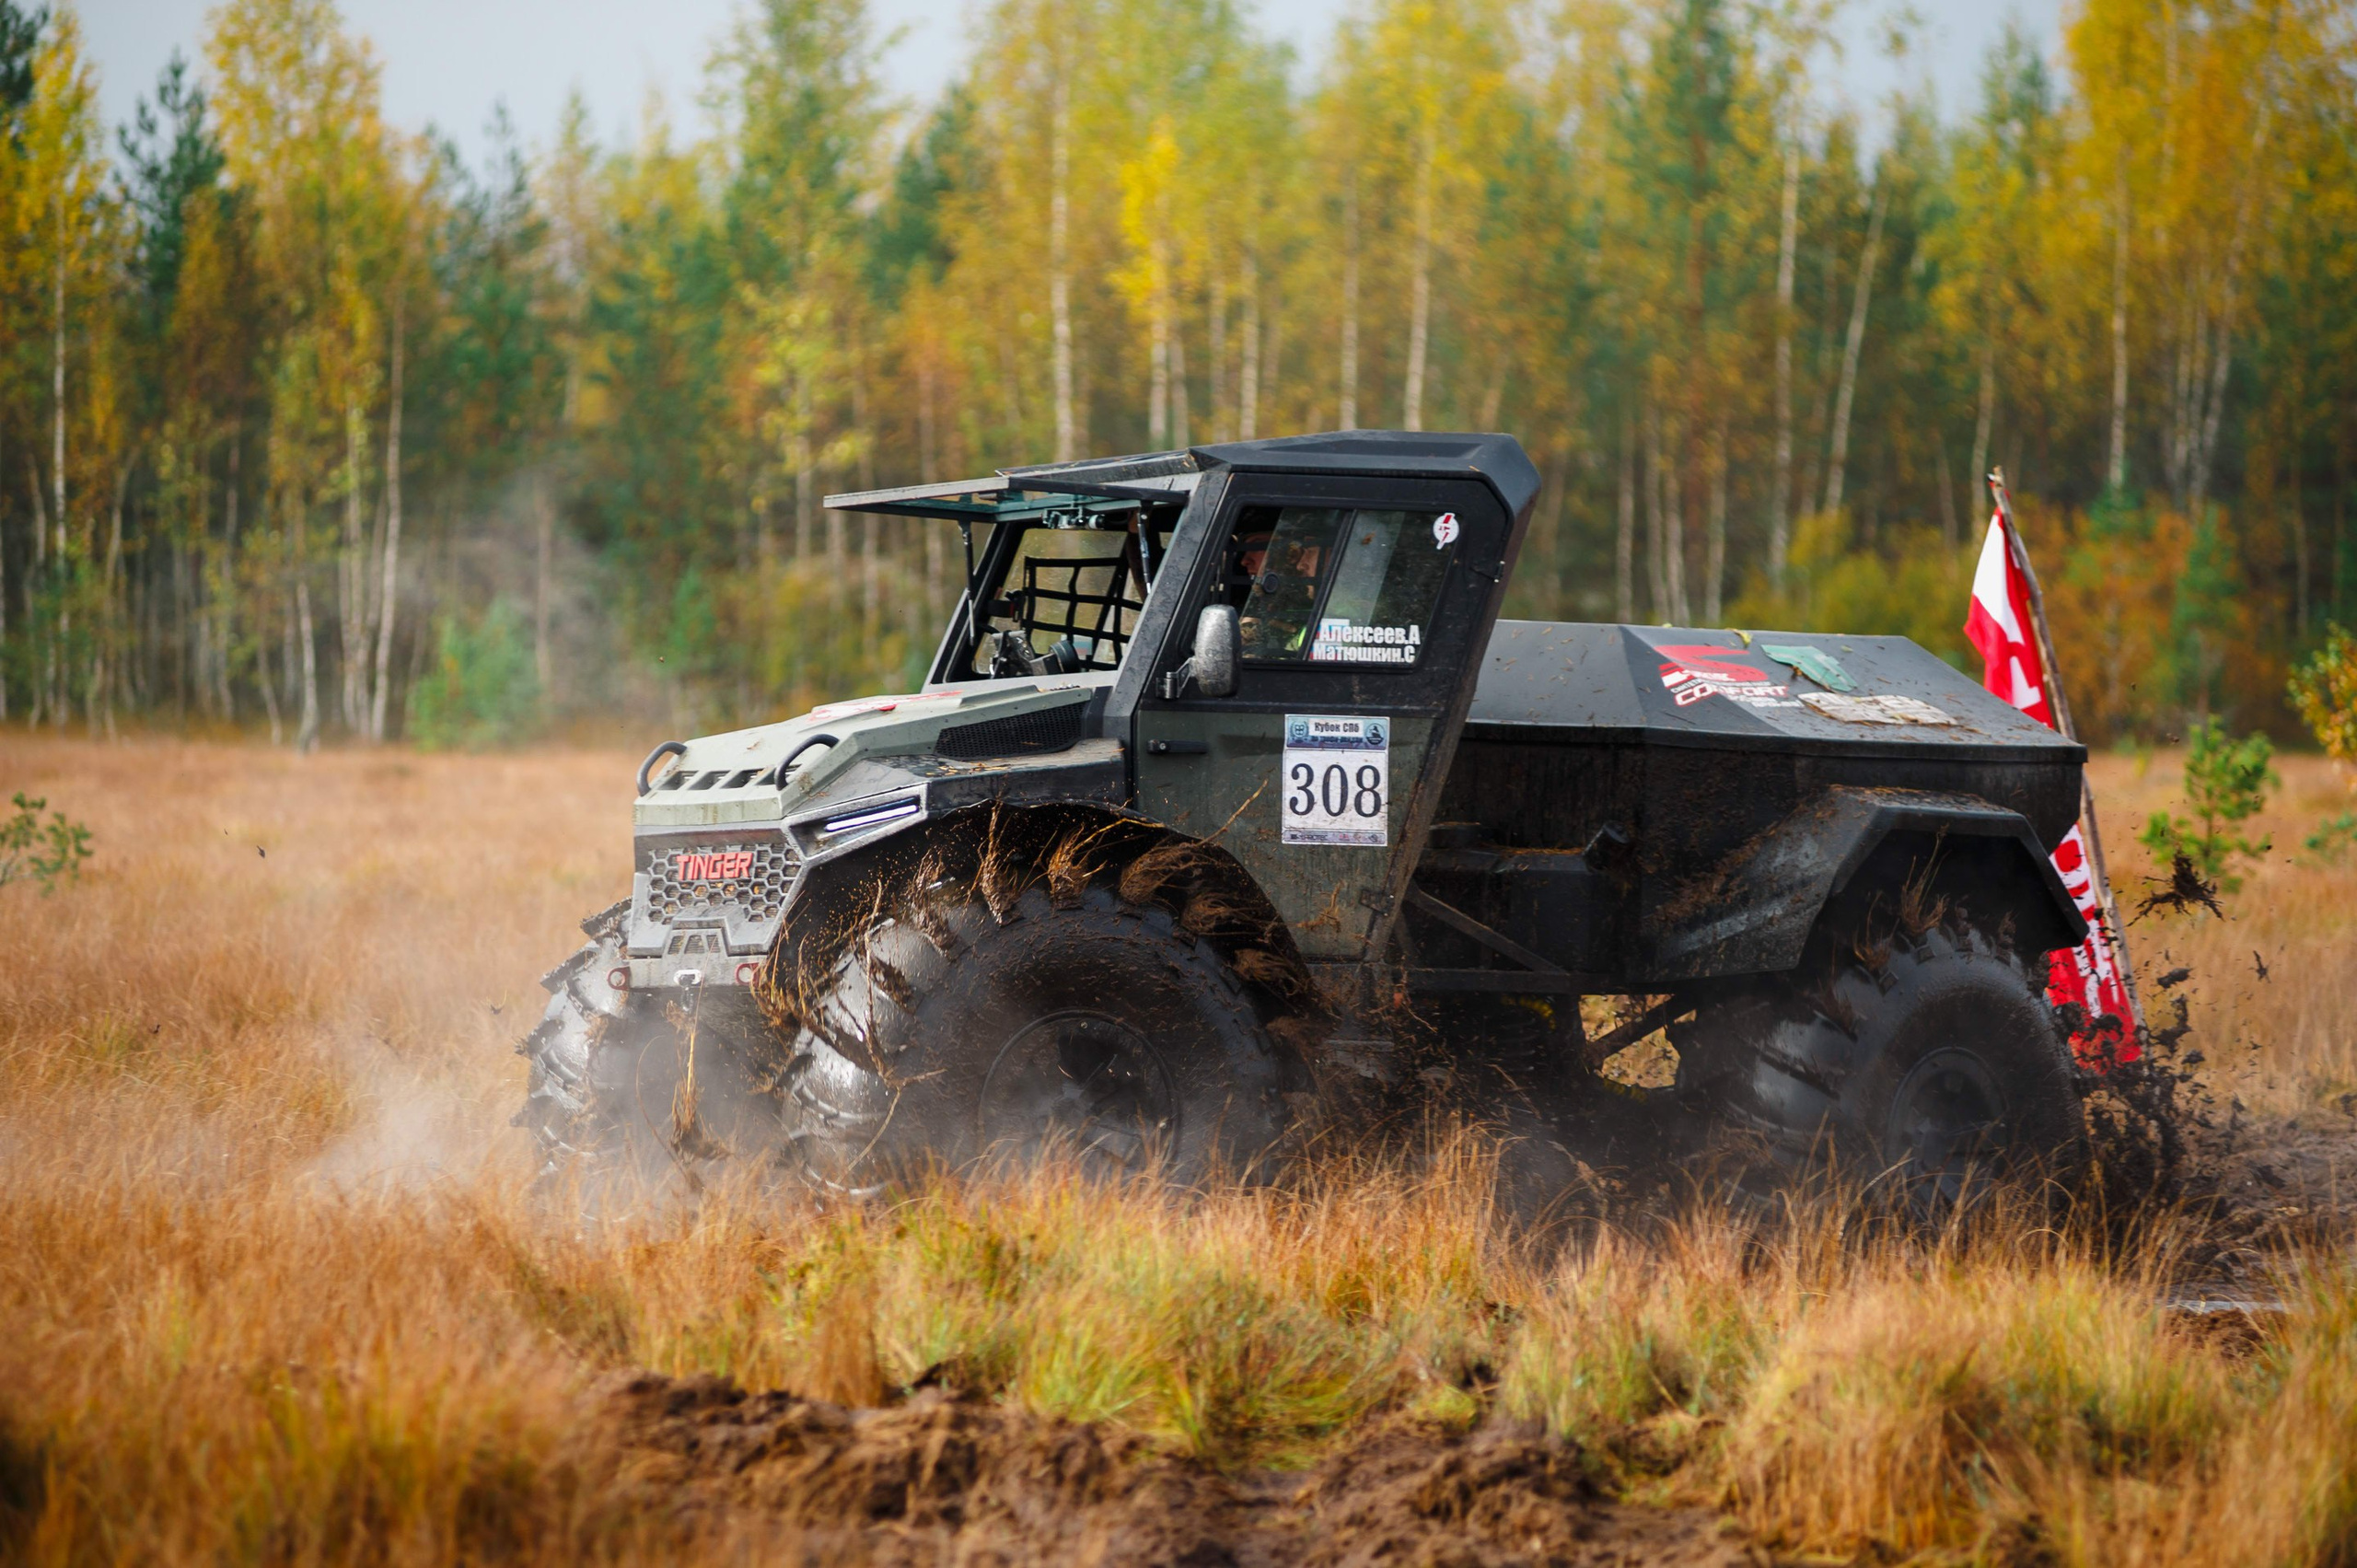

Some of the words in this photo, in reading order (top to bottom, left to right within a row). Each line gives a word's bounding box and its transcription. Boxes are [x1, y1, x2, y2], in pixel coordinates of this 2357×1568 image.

[1319, 624, 1421, 645] Алексеев.А
[1312, 643, 1416, 663] Матюшкин.С
[1314, 722, 1341, 733] Кубок
[1342, 723, 1360, 733] СПб
[1289, 763, 1382, 817] 308
[676, 852, 752, 880] TINGER
